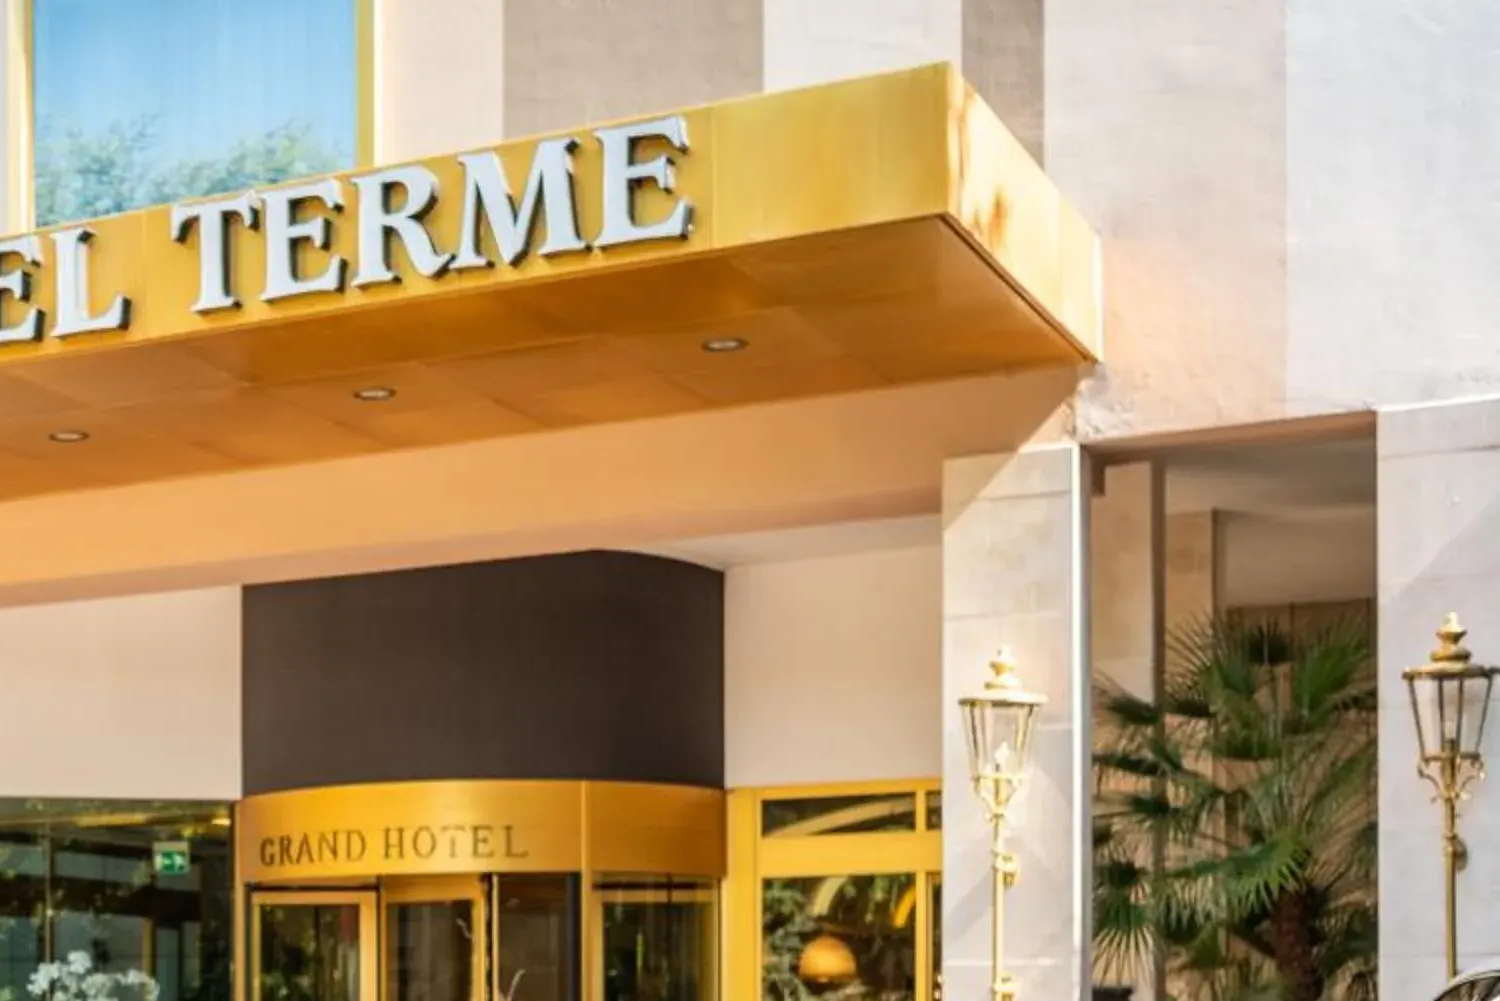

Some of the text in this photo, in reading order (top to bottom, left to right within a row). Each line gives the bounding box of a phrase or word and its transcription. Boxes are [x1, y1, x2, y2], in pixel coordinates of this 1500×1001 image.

[170, 116, 694, 313] TERME
[260, 824, 529, 867] GRAND HOTEL
